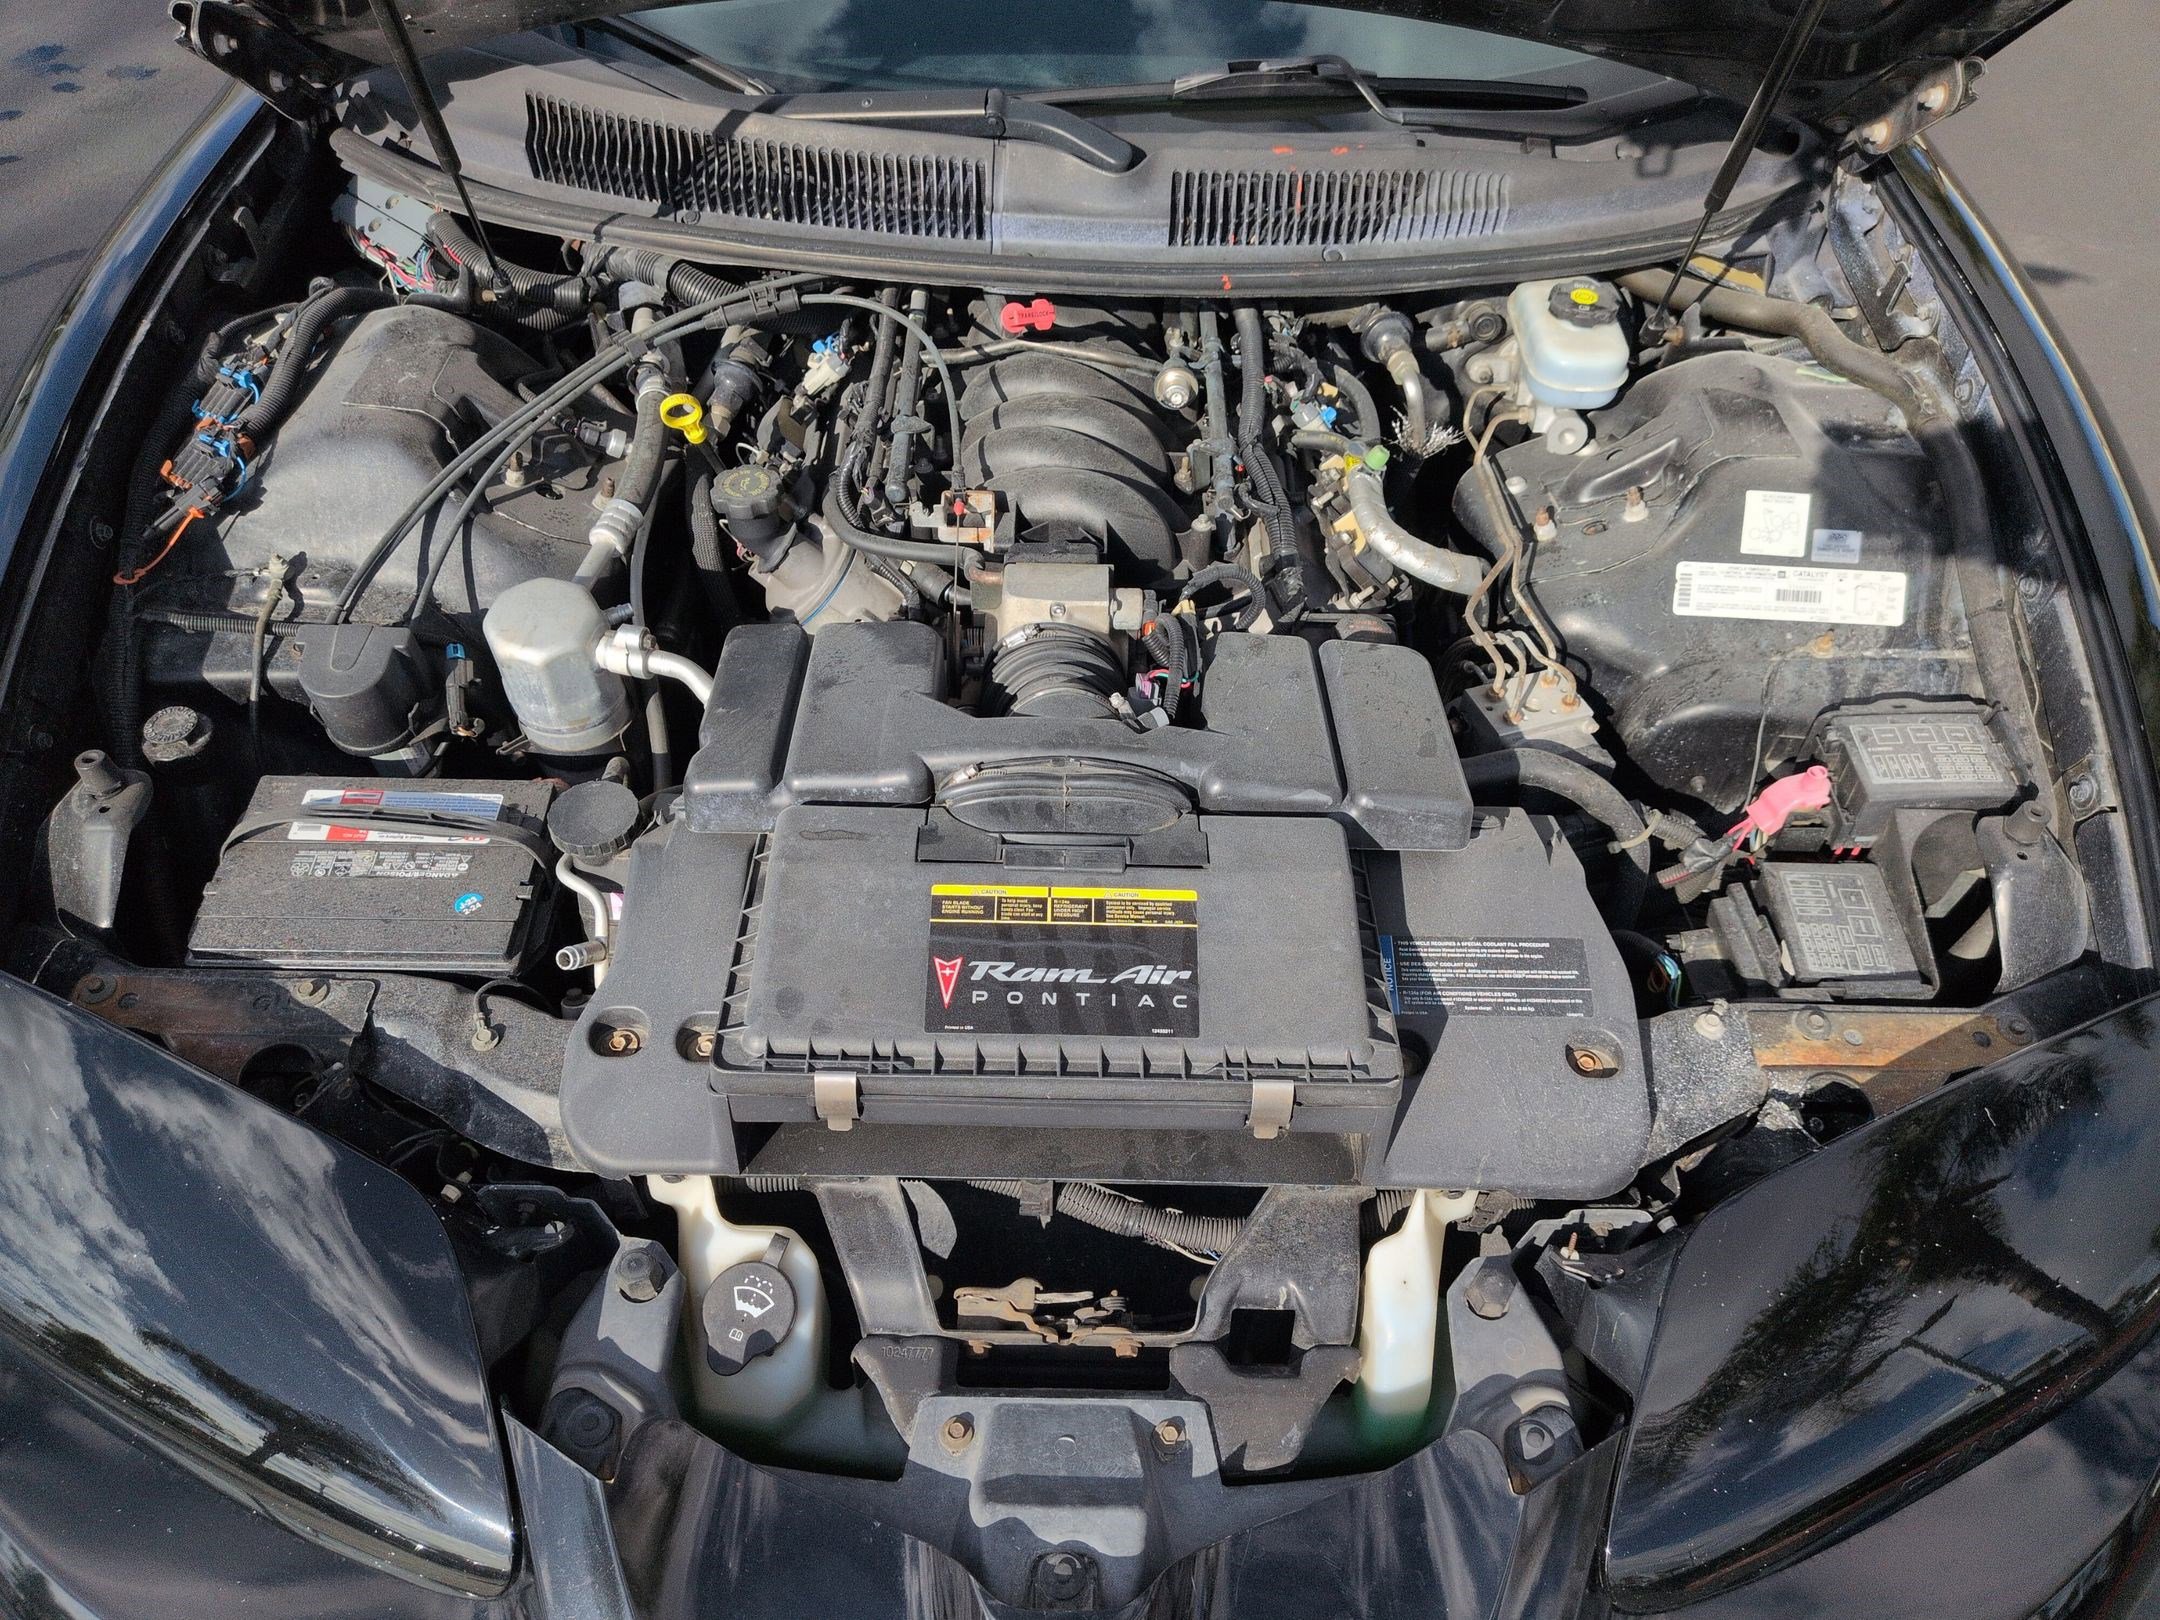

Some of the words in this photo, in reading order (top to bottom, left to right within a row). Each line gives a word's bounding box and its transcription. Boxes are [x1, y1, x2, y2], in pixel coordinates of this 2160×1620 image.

[968, 960, 1107, 984] Ram
[1110, 964, 1192, 985] Air
[1384, 958, 1394, 991] NOTICE
[972, 990, 1188, 1008] PONTIAC
[882, 1346, 934, 1359] 10247777
